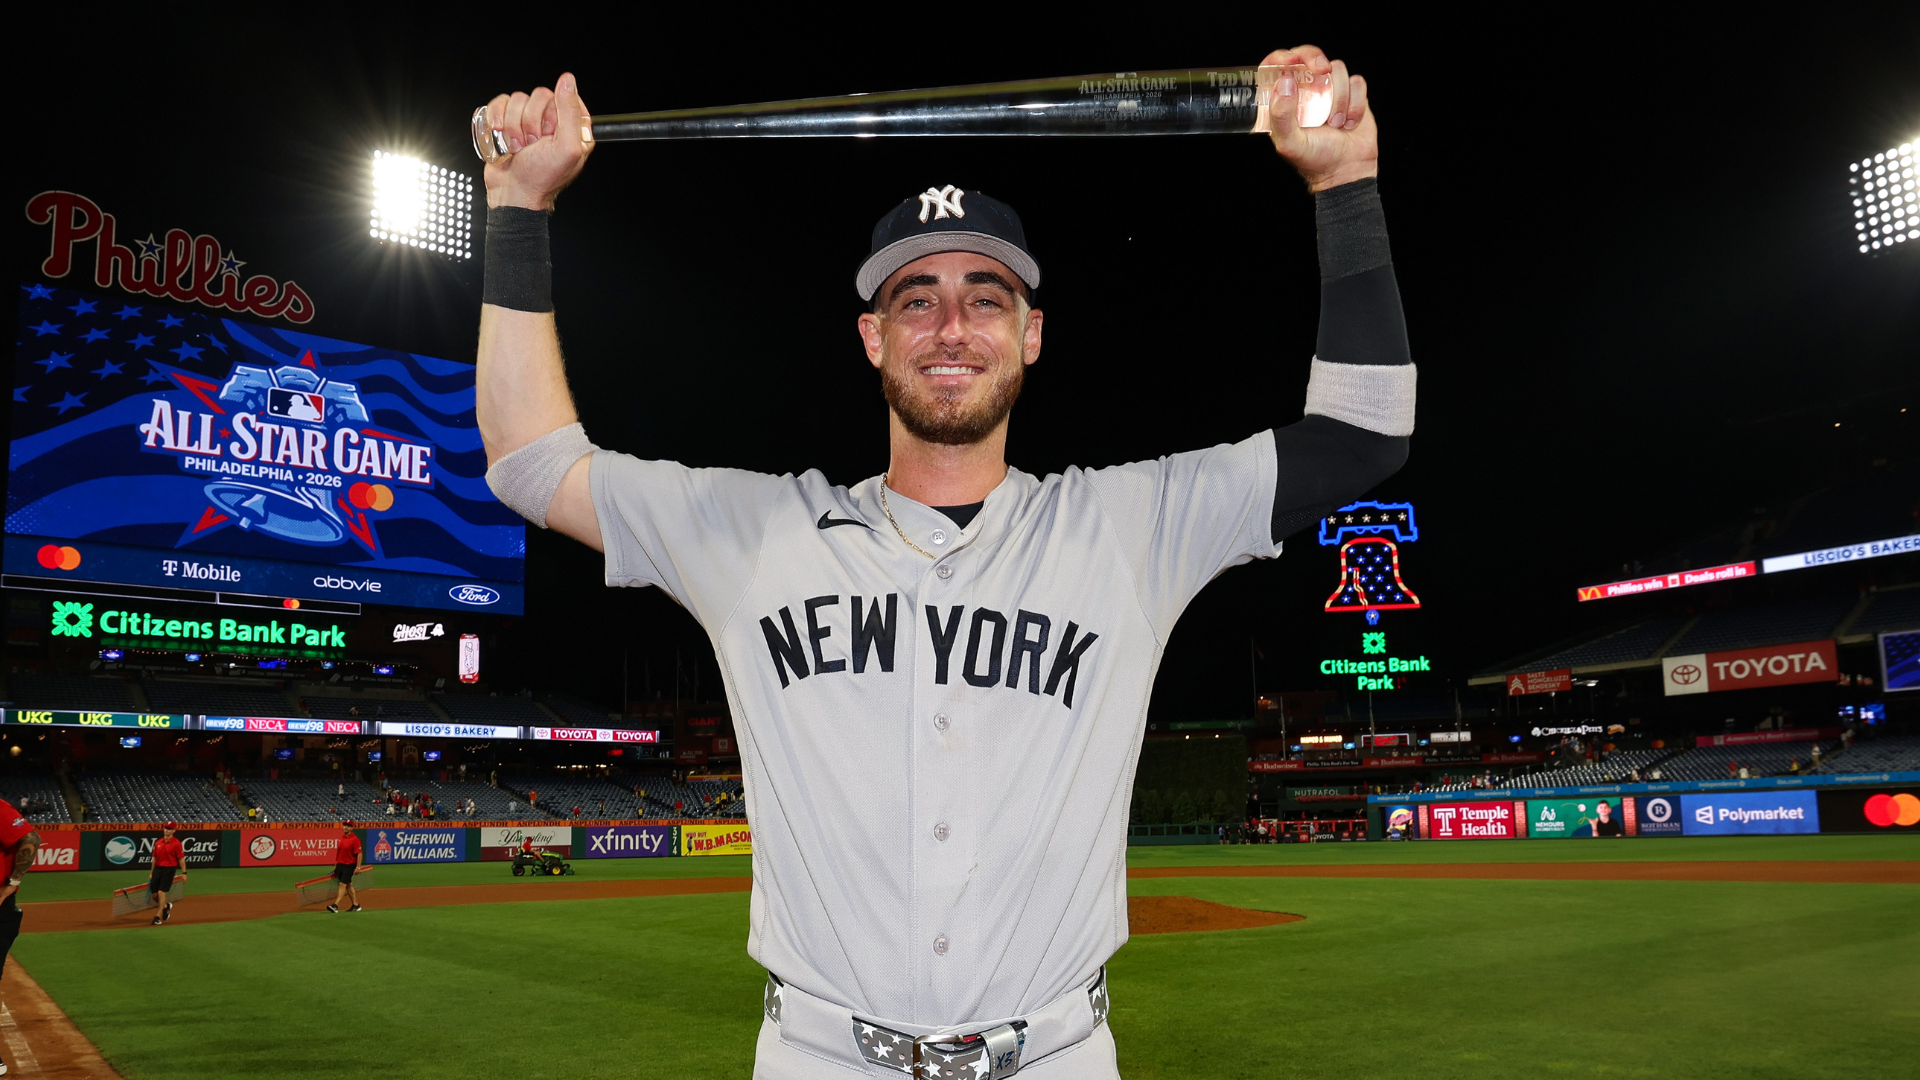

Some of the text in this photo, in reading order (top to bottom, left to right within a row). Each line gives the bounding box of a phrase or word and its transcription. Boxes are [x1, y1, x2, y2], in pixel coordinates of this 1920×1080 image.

[1079, 76, 1178, 94] ALL STAR GAME
[1207, 71, 1238, 87] TED
[1219, 87, 1252, 107] MVP
[25, 190, 315, 323] Phillies
[139, 398, 432, 484] ALL STAR GAME
[184, 455, 342, 488] PHILADELPHIA 2026
[1804, 546, 1865, 565] LISCIO'S
[181, 561, 241, 583] Mobile
[1607, 565, 1747, 596] Phillies win Deals roll in
[313, 574, 382, 593] abbvie
[459, 587, 491, 602] Ford
[100, 609, 346, 648] Citizens Bank Park
[392, 622, 434, 643] GHOST
[759, 592, 1099, 710] NEW YORK
[1320, 655, 1431, 675] Citizens Bank
[1713, 652, 1827, 681] TOYOTA
[1357, 673, 1394, 690] Park
[17, 710, 170, 728] UKG UKG UKG
[248, 719, 285, 731] NECA
[326, 722, 360, 733] NECA
[688, 716, 723, 727] GIANT
[405, 724, 496, 737] LISCIO'S BAKERY
[553, 729, 653, 742] TOYOTA TOYOTA
[1294, 789, 1340, 797] NUTRAFOL
[1460, 806, 1509, 823] Temple
[1654, 805, 1665, 816] R
[1718, 806, 1804, 823] Polymarket
[216, 822, 271, 830] ASPLUNDH
[404, 821, 453, 829] ASPLUNDH
[1461, 821, 1508, 837] Health
[137, 836, 219, 853] NCare
[280, 839, 301, 850] F.W.
[394, 831, 455, 845] SHERWIN
[590, 828, 663, 854] xfinity
[393, 846, 456, 860] WILLIAMS
[996, 1050, 1015, 1071] X3
